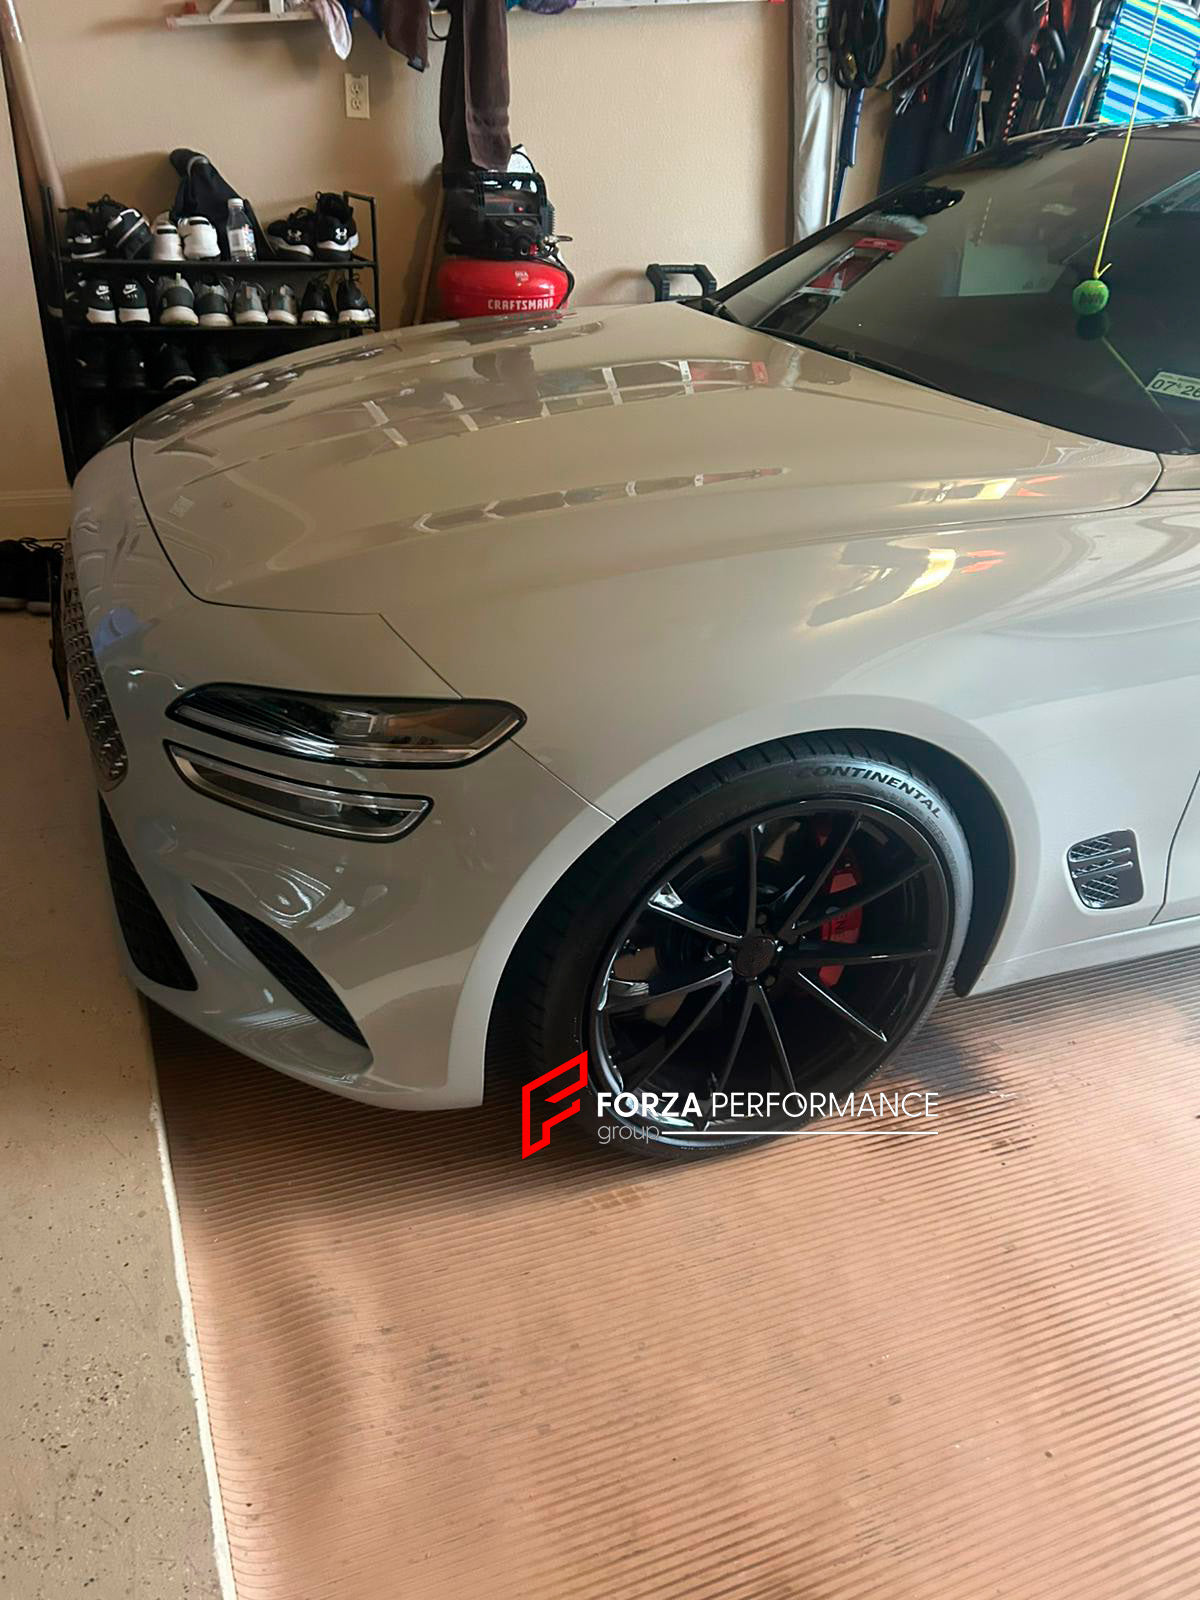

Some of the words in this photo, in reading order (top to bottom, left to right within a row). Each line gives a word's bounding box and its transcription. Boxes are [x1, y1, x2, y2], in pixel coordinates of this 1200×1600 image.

[815, 0, 829, 83] LBELLO
[487, 298, 552, 311] CRAFTSMAN
[796, 765, 941, 819] CONTINENTAL
